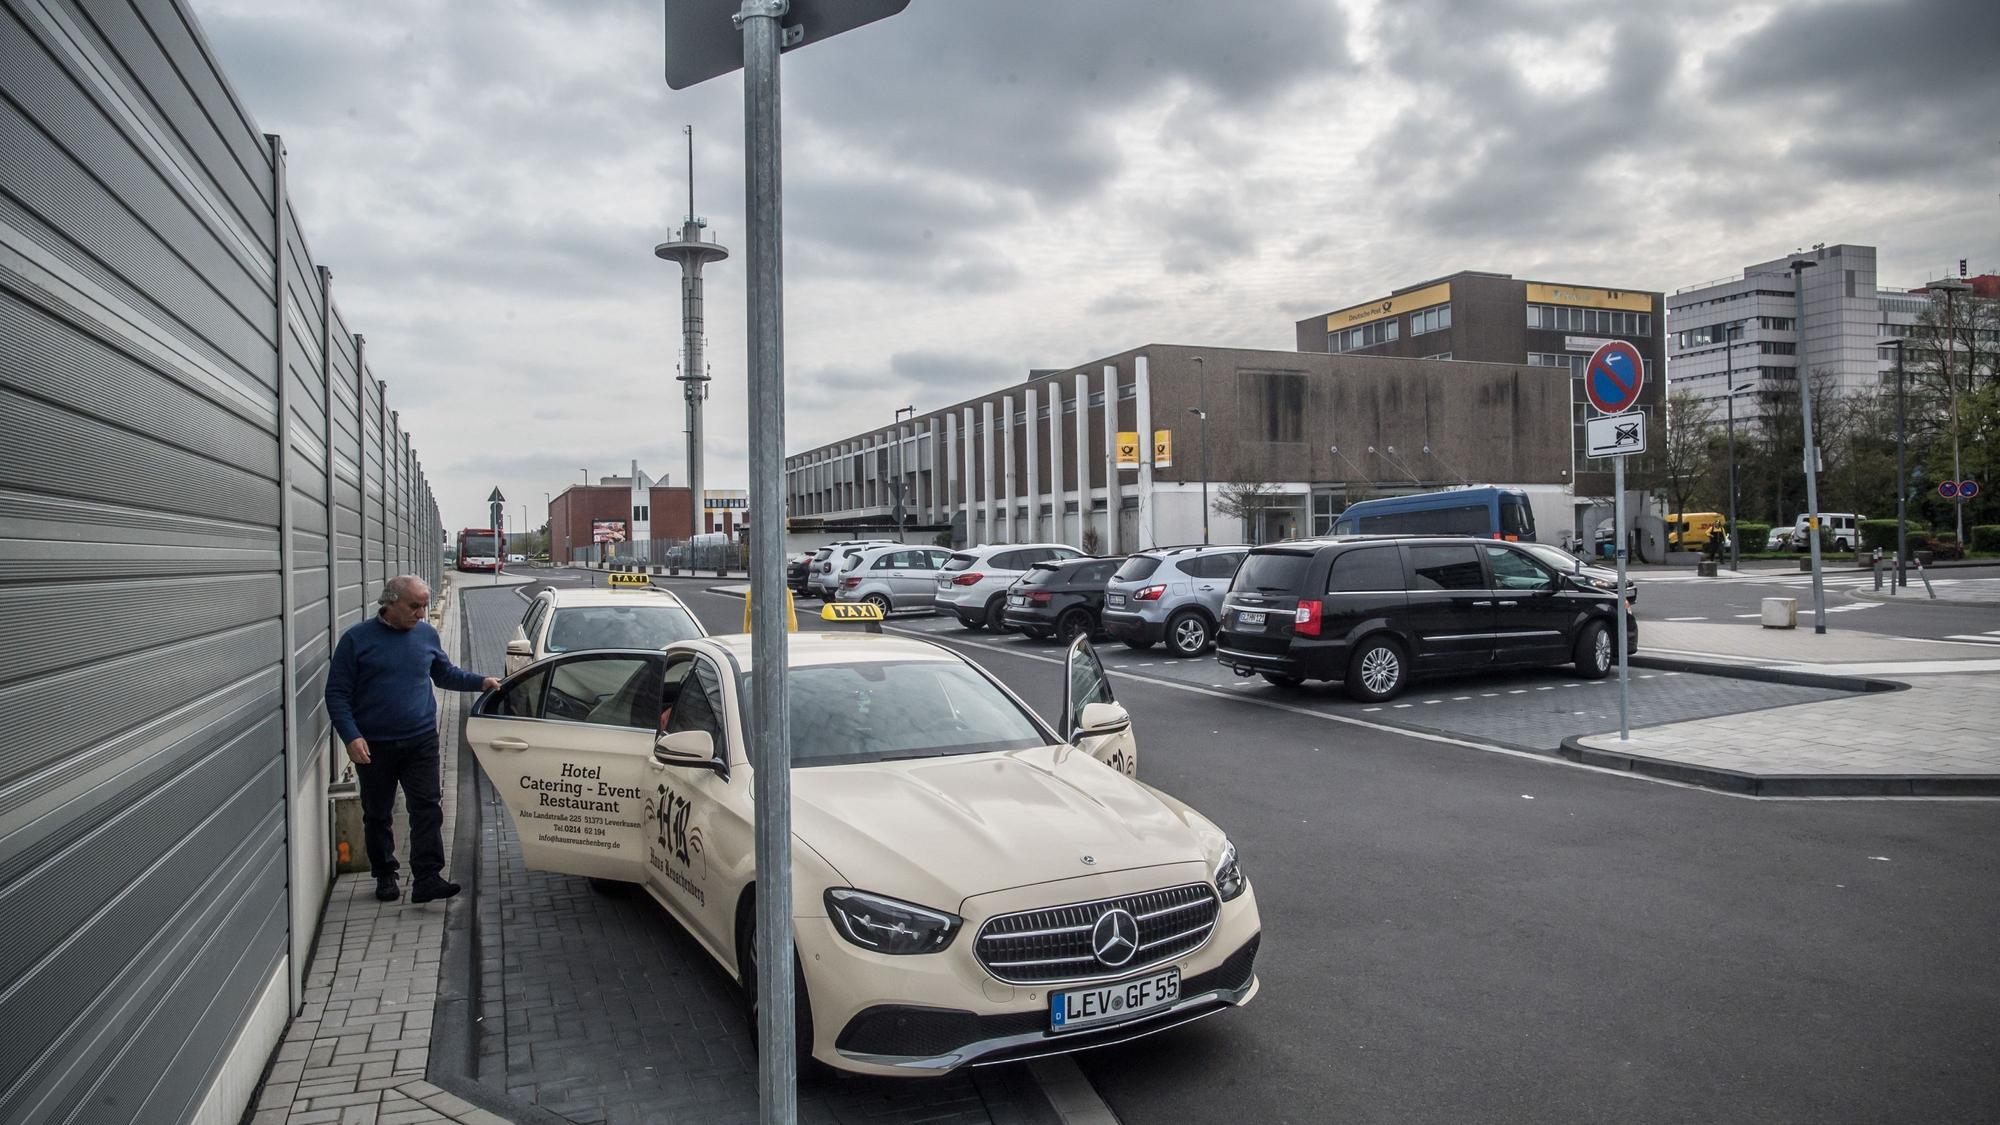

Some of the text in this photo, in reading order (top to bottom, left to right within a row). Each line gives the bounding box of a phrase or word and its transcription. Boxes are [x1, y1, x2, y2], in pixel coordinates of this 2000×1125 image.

[1348, 307, 1381, 321] Deutsche Post
[834, 605, 876, 617] TAXI
[561, 763, 601, 779] Hotel
[520, 776, 582, 797] Catering
[598, 782, 641, 799] Event
[540, 793, 620, 813] Restaurant
[520, 810, 532, 818] Alte
[533, 811, 568, 821] Landstraße
[584, 816, 603, 825] 51373
[604, 818, 641, 828] Leverkusen
[564, 825, 581, 833] 0214
[584, 827, 593, 835] 62
[594, 828, 606, 837] 194
[1067, 989, 1112, 1019] LEV
[1126, 980, 1152, 1009] GF
[1155, 973, 1178, 1001] 55
